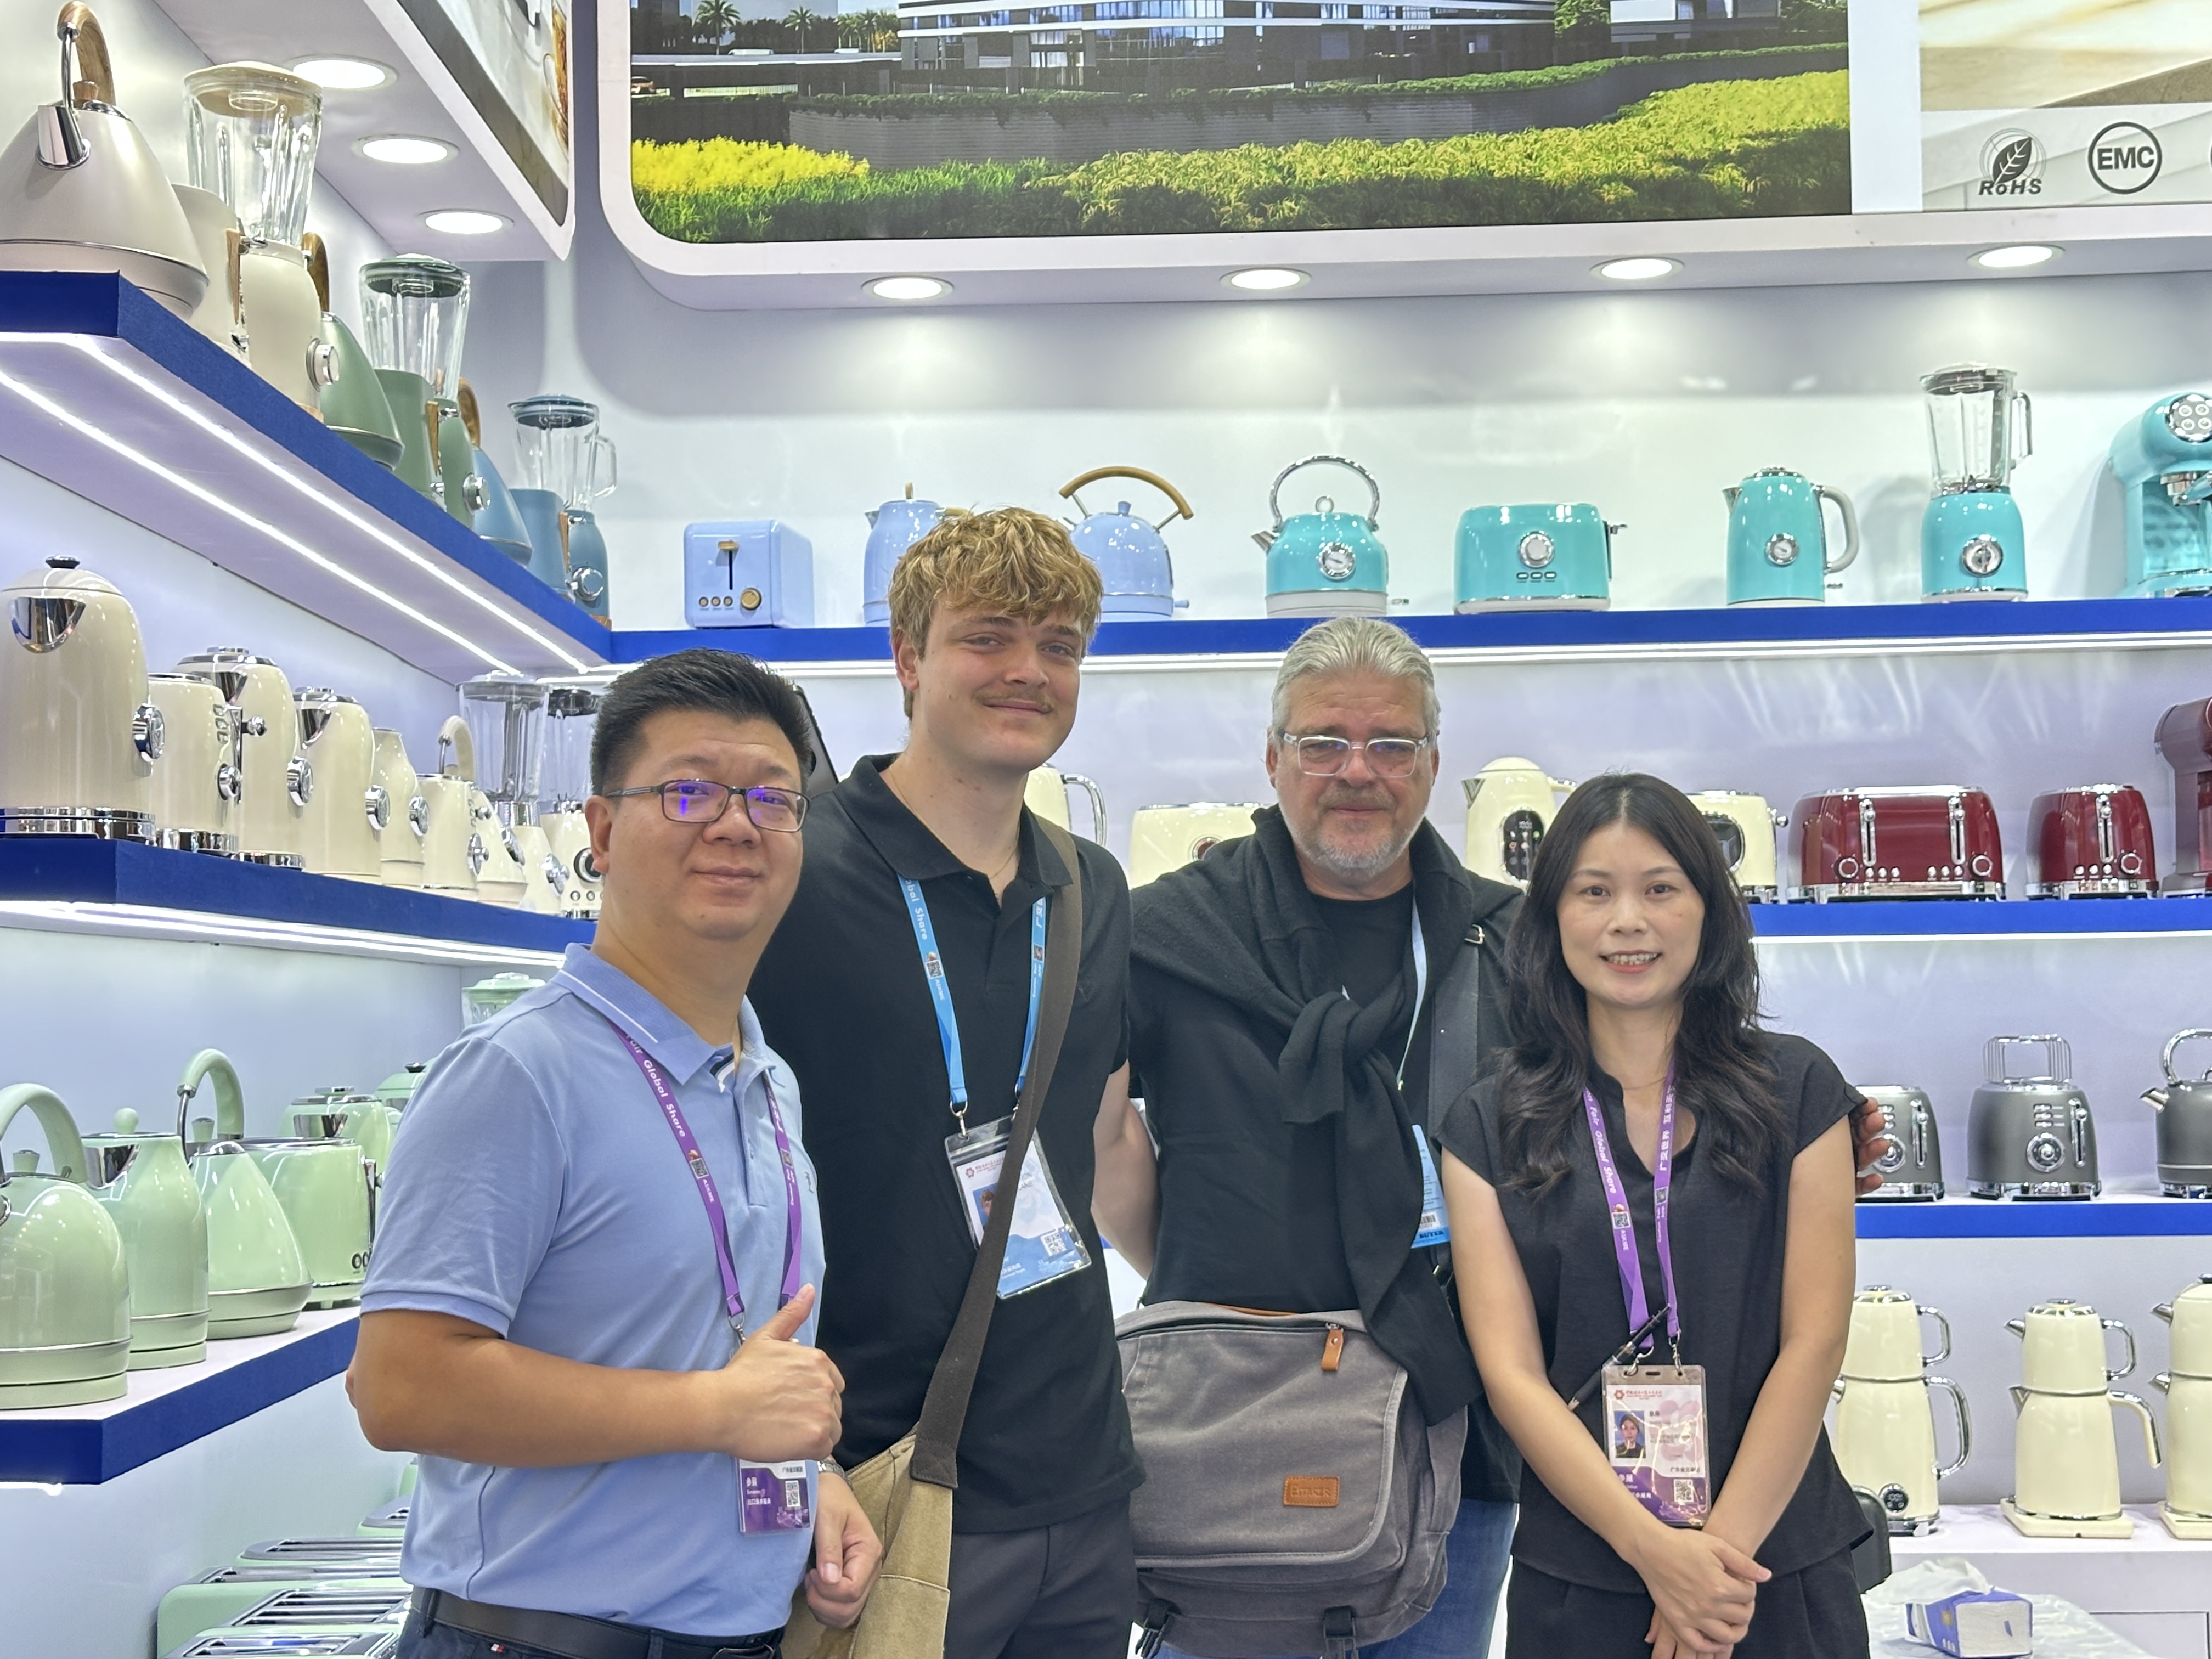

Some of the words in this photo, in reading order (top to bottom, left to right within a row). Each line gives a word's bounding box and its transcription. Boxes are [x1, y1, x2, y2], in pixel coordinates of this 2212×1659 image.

[2097, 146, 2155, 170] EMC
[1978, 178, 2042, 196] RoHS
[915, 907, 928, 940] Share
[644, 1059, 669, 1098] Global
[665, 1103, 685, 1137] Share
[1590, 1106, 1599, 1126] Fair
[1595, 1130, 1609, 1163] Global
[1603, 1166, 1617, 1194] Share
[702, 1179, 715, 1203] ASKME
